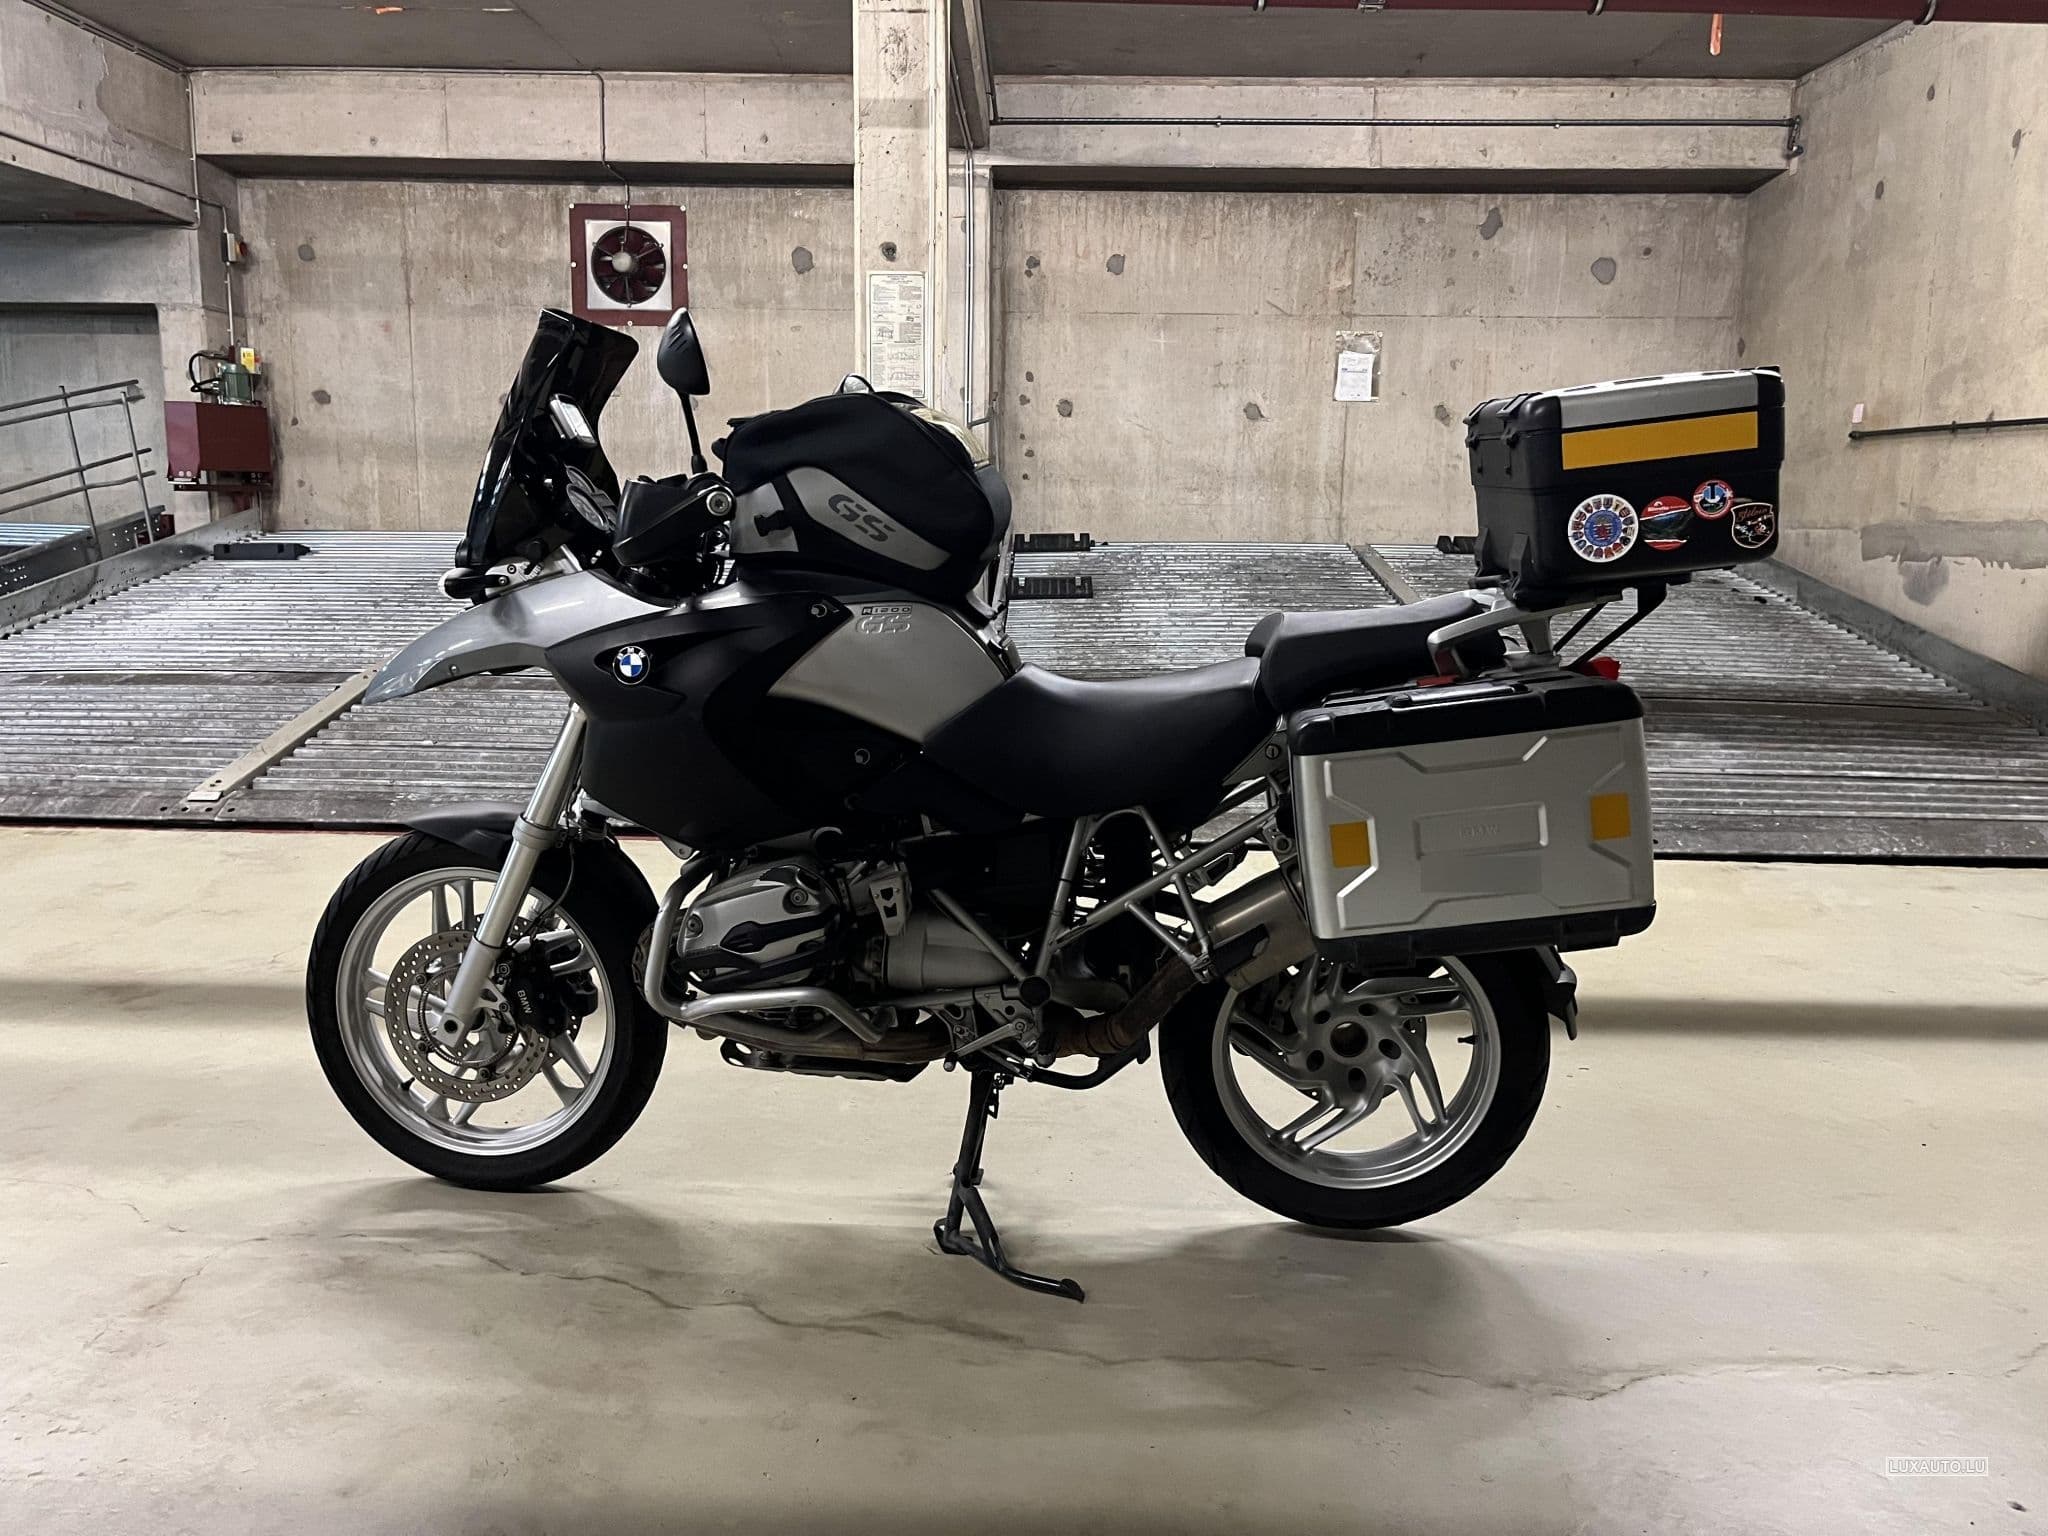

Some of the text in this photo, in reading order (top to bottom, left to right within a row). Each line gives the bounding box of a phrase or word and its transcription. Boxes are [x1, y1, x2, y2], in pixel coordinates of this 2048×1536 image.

[828, 494, 896, 542] GS
[616, 647, 647, 660] BMW
[517, 989, 533, 1014] BMW
